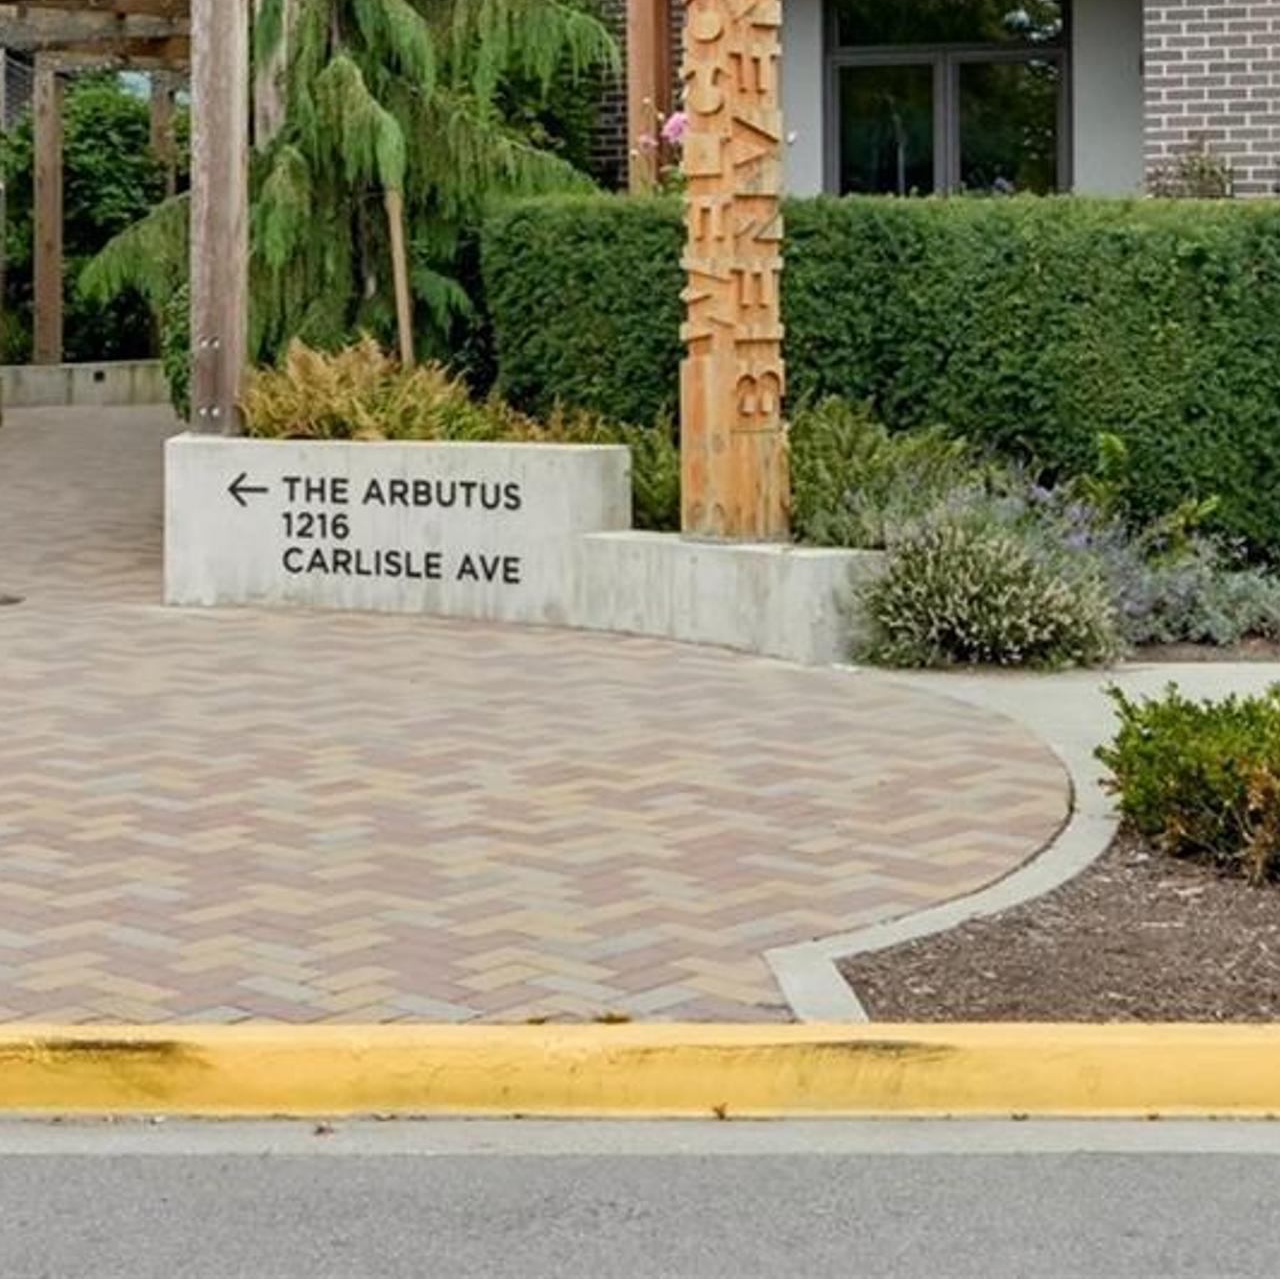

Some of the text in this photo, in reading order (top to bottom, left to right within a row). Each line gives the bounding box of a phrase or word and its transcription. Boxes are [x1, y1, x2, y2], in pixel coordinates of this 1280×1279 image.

[282, 477, 522, 511] THE ARBUTUS
[282, 512, 350, 540] 1216
[282, 547, 521, 585] CARLISLE AVE
